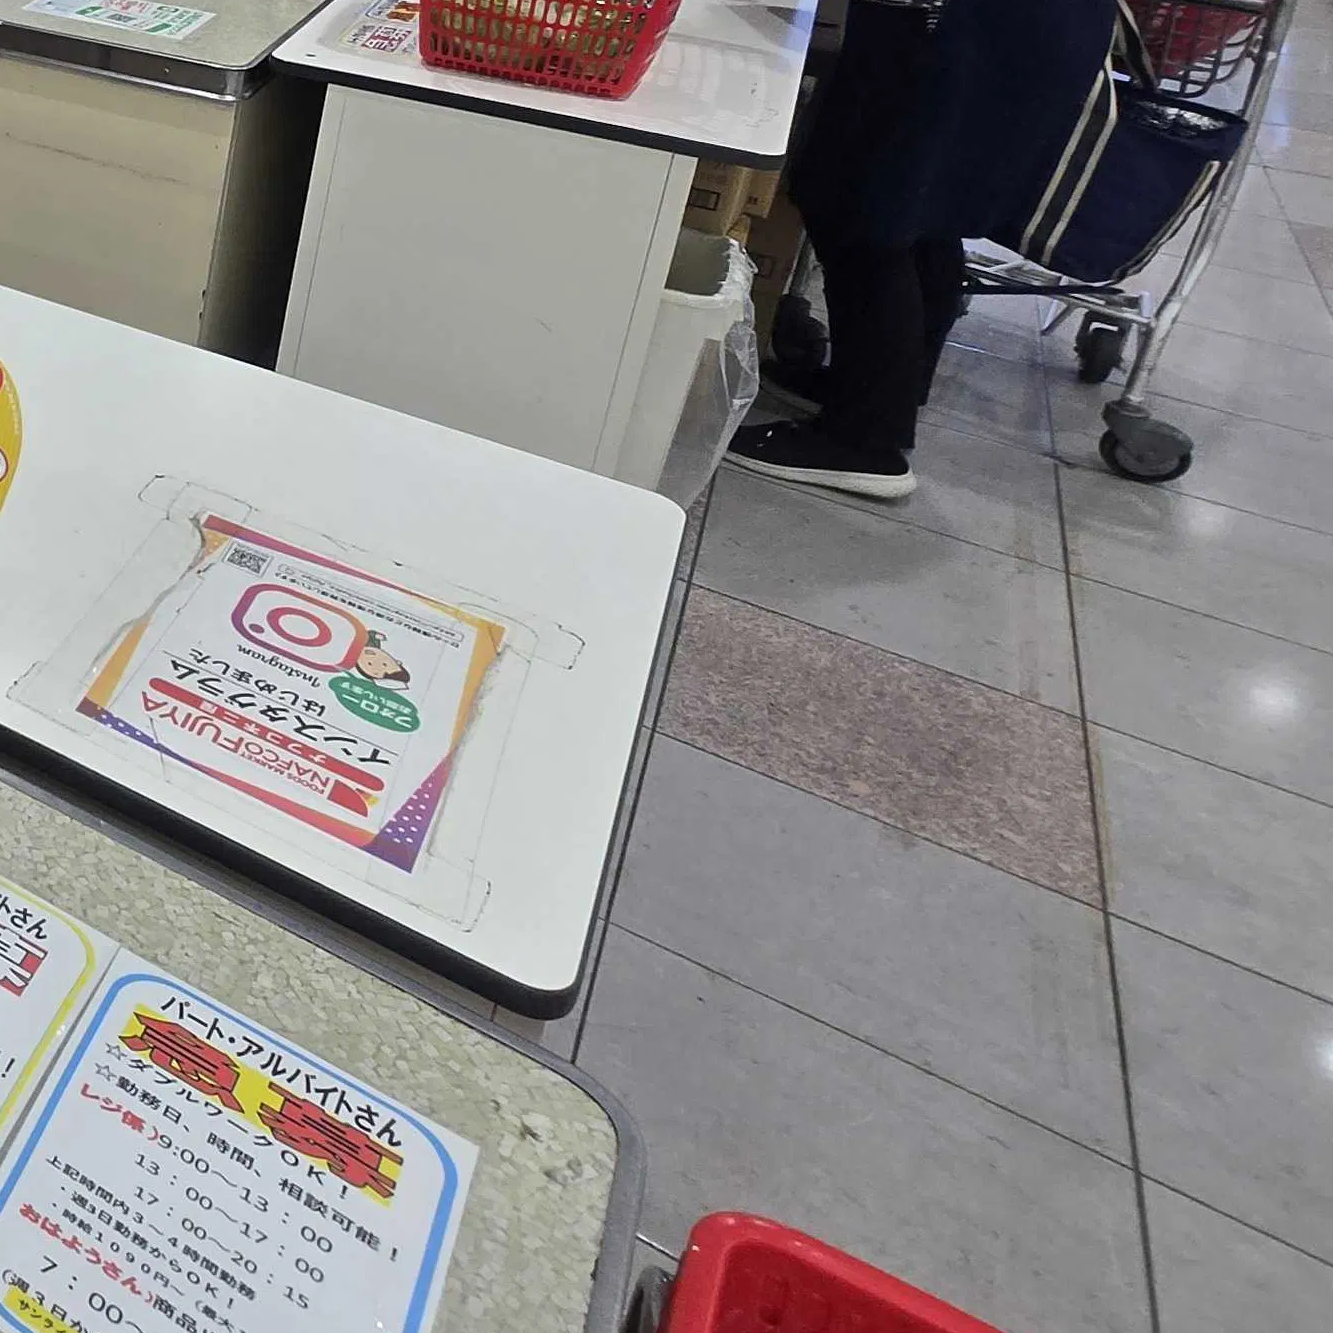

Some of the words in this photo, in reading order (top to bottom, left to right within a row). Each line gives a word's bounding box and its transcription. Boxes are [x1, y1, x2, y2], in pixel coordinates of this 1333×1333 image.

[188, 646, 326, 716] はじめました
[237, 643, 322, 689] Instagram
[141, 690, 245, 753] FUJIYA
[169, 658, 393, 766] インスタグラム
[199, 698, 329, 766] ナフコ不二屋
[347, 692, 415, 730] フォロー
[243, 742, 331, 788] NAFCO
[119, 1010, 404, 1201] 急募
[160, 993, 404, 1150] パート・アルバイトさん
